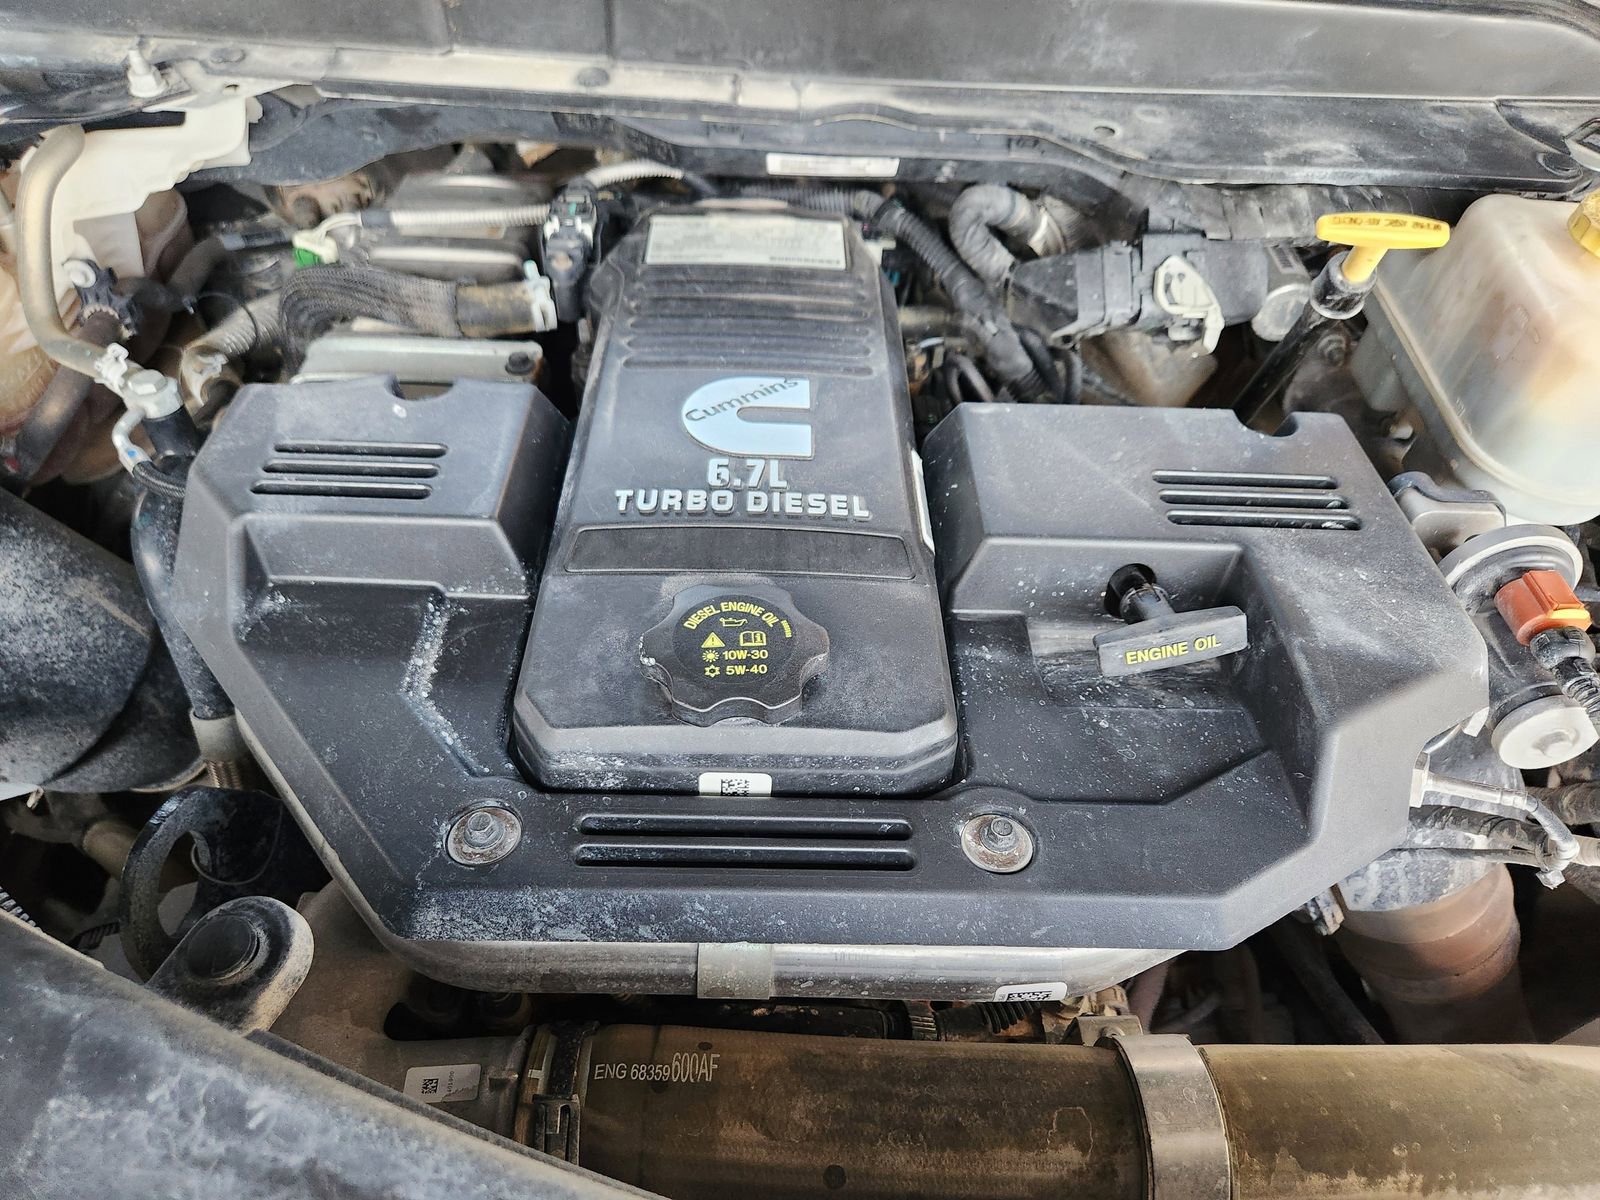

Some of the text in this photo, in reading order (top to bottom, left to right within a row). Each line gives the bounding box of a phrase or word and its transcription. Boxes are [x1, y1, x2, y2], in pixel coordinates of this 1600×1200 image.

[685, 378, 799, 422] Cummins
[708, 458, 788, 489] 6.7L
[615, 489, 871, 520] TURBO DIESEL
[683, 601, 780, 630] DIESEL ENGINE OIL
[722, 649, 769, 660] 10W-30
[1125, 634, 1222, 665] ENGINE OIL
[725, 664, 768, 676] 5W-40
[594, 1063, 628, 1080] ENG
